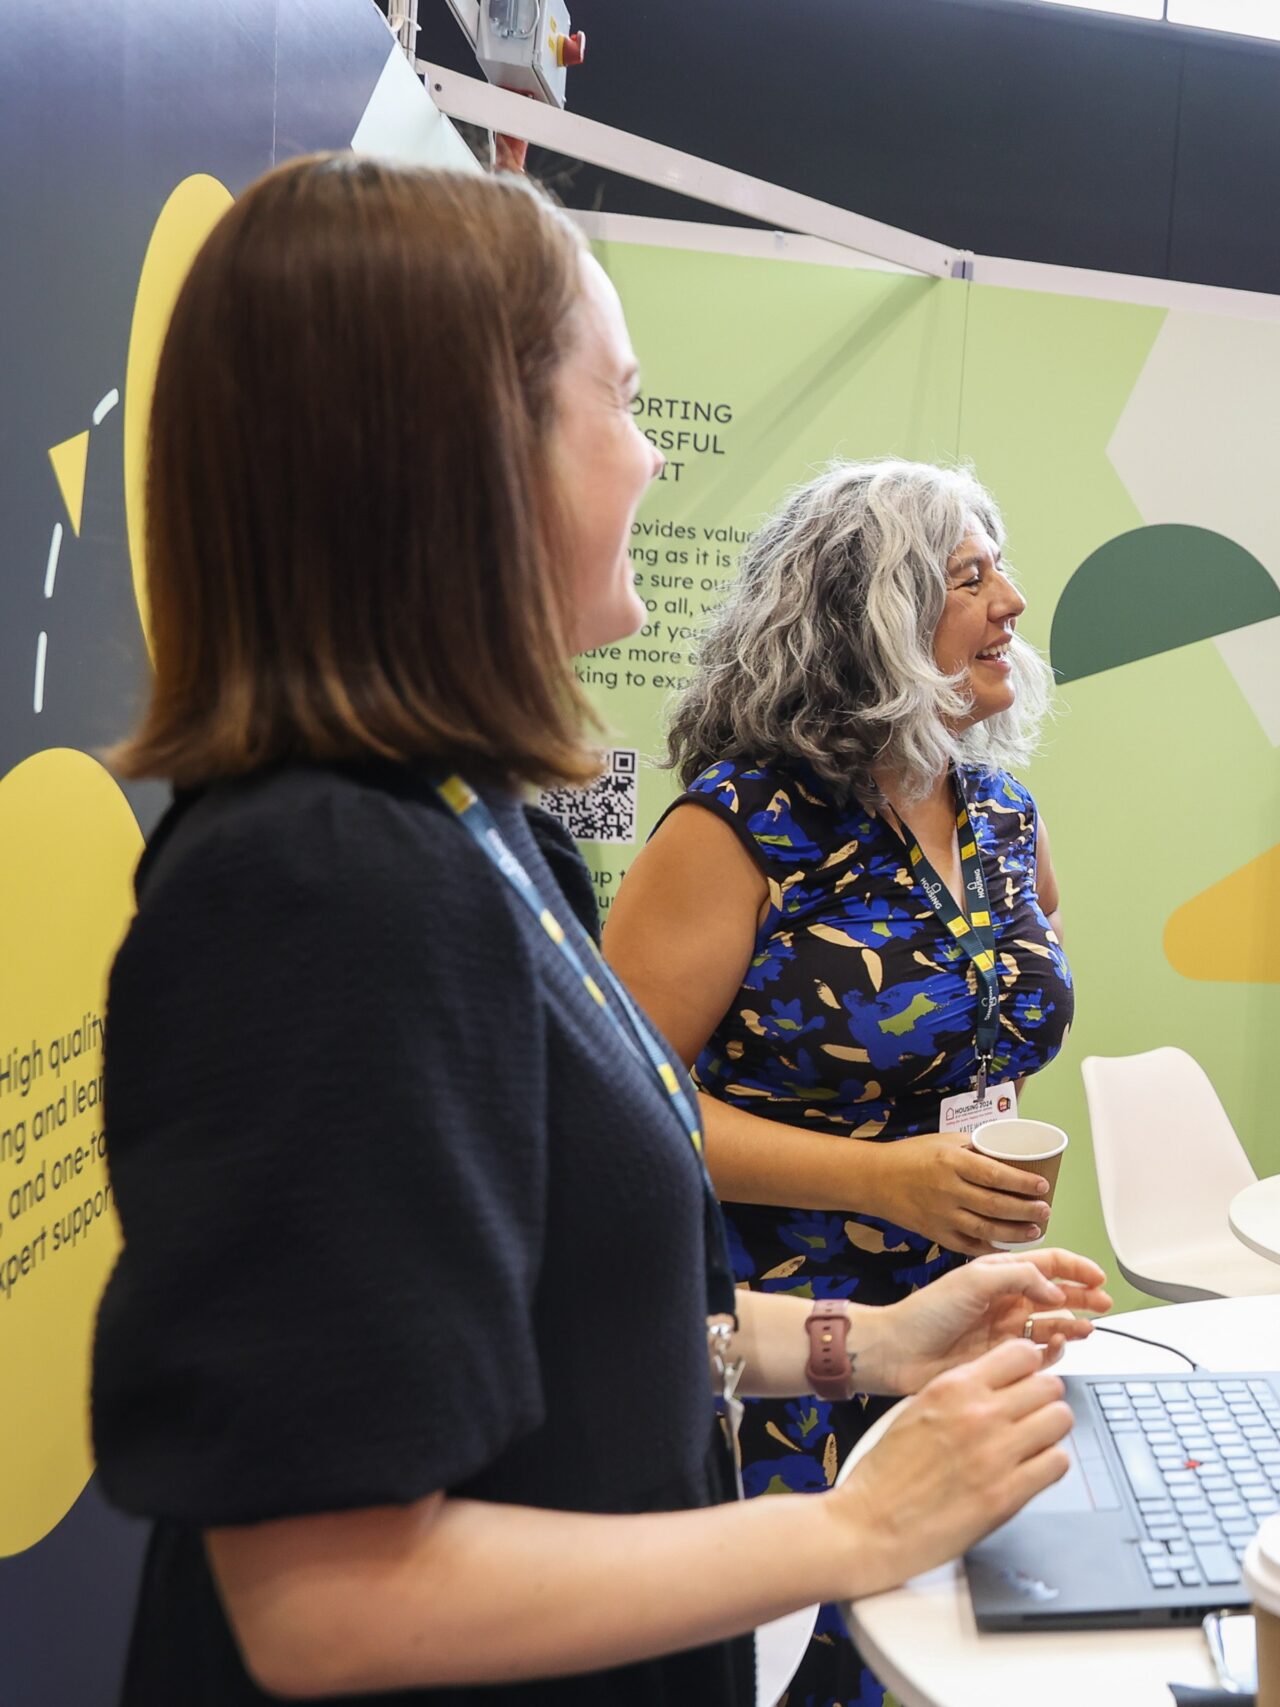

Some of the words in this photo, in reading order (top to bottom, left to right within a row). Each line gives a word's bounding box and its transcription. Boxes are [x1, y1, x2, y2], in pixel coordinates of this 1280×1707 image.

[631, 396, 733, 424] ORTING
[644, 429, 725, 454] SSFUL
[659, 461, 685, 482] IT
[631, 519, 697, 540] ovides
[704, 525, 750, 544] valu
[665, 550, 689, 564] as
[696, 547, 710, 566] it
[716, 549, 732, 568] is
[650, 573, 694, 590] sure
[641, 597, 657, 612] o
[664, 597, 694, 619] all,
[640, 620, 661, 638] of
[628, 648, 682, 664] more
[574, 665, 618, 690] king
[625, 671, 646, 688] to
[652, 675, 690, 691] exp
[920, 877, 943, 910] HOUSING
[974, 868, 986, 899] HOUSING
[0, 1120, 27, 1165] ng
[32, 1085, 67, 1141] and
[9, 1159, 46, 1220] and
[52, 1131, 108, 1190] one-to
[0, 1226, 46, 1300] xpert
[52, 1183, 113, 1251] suppor
